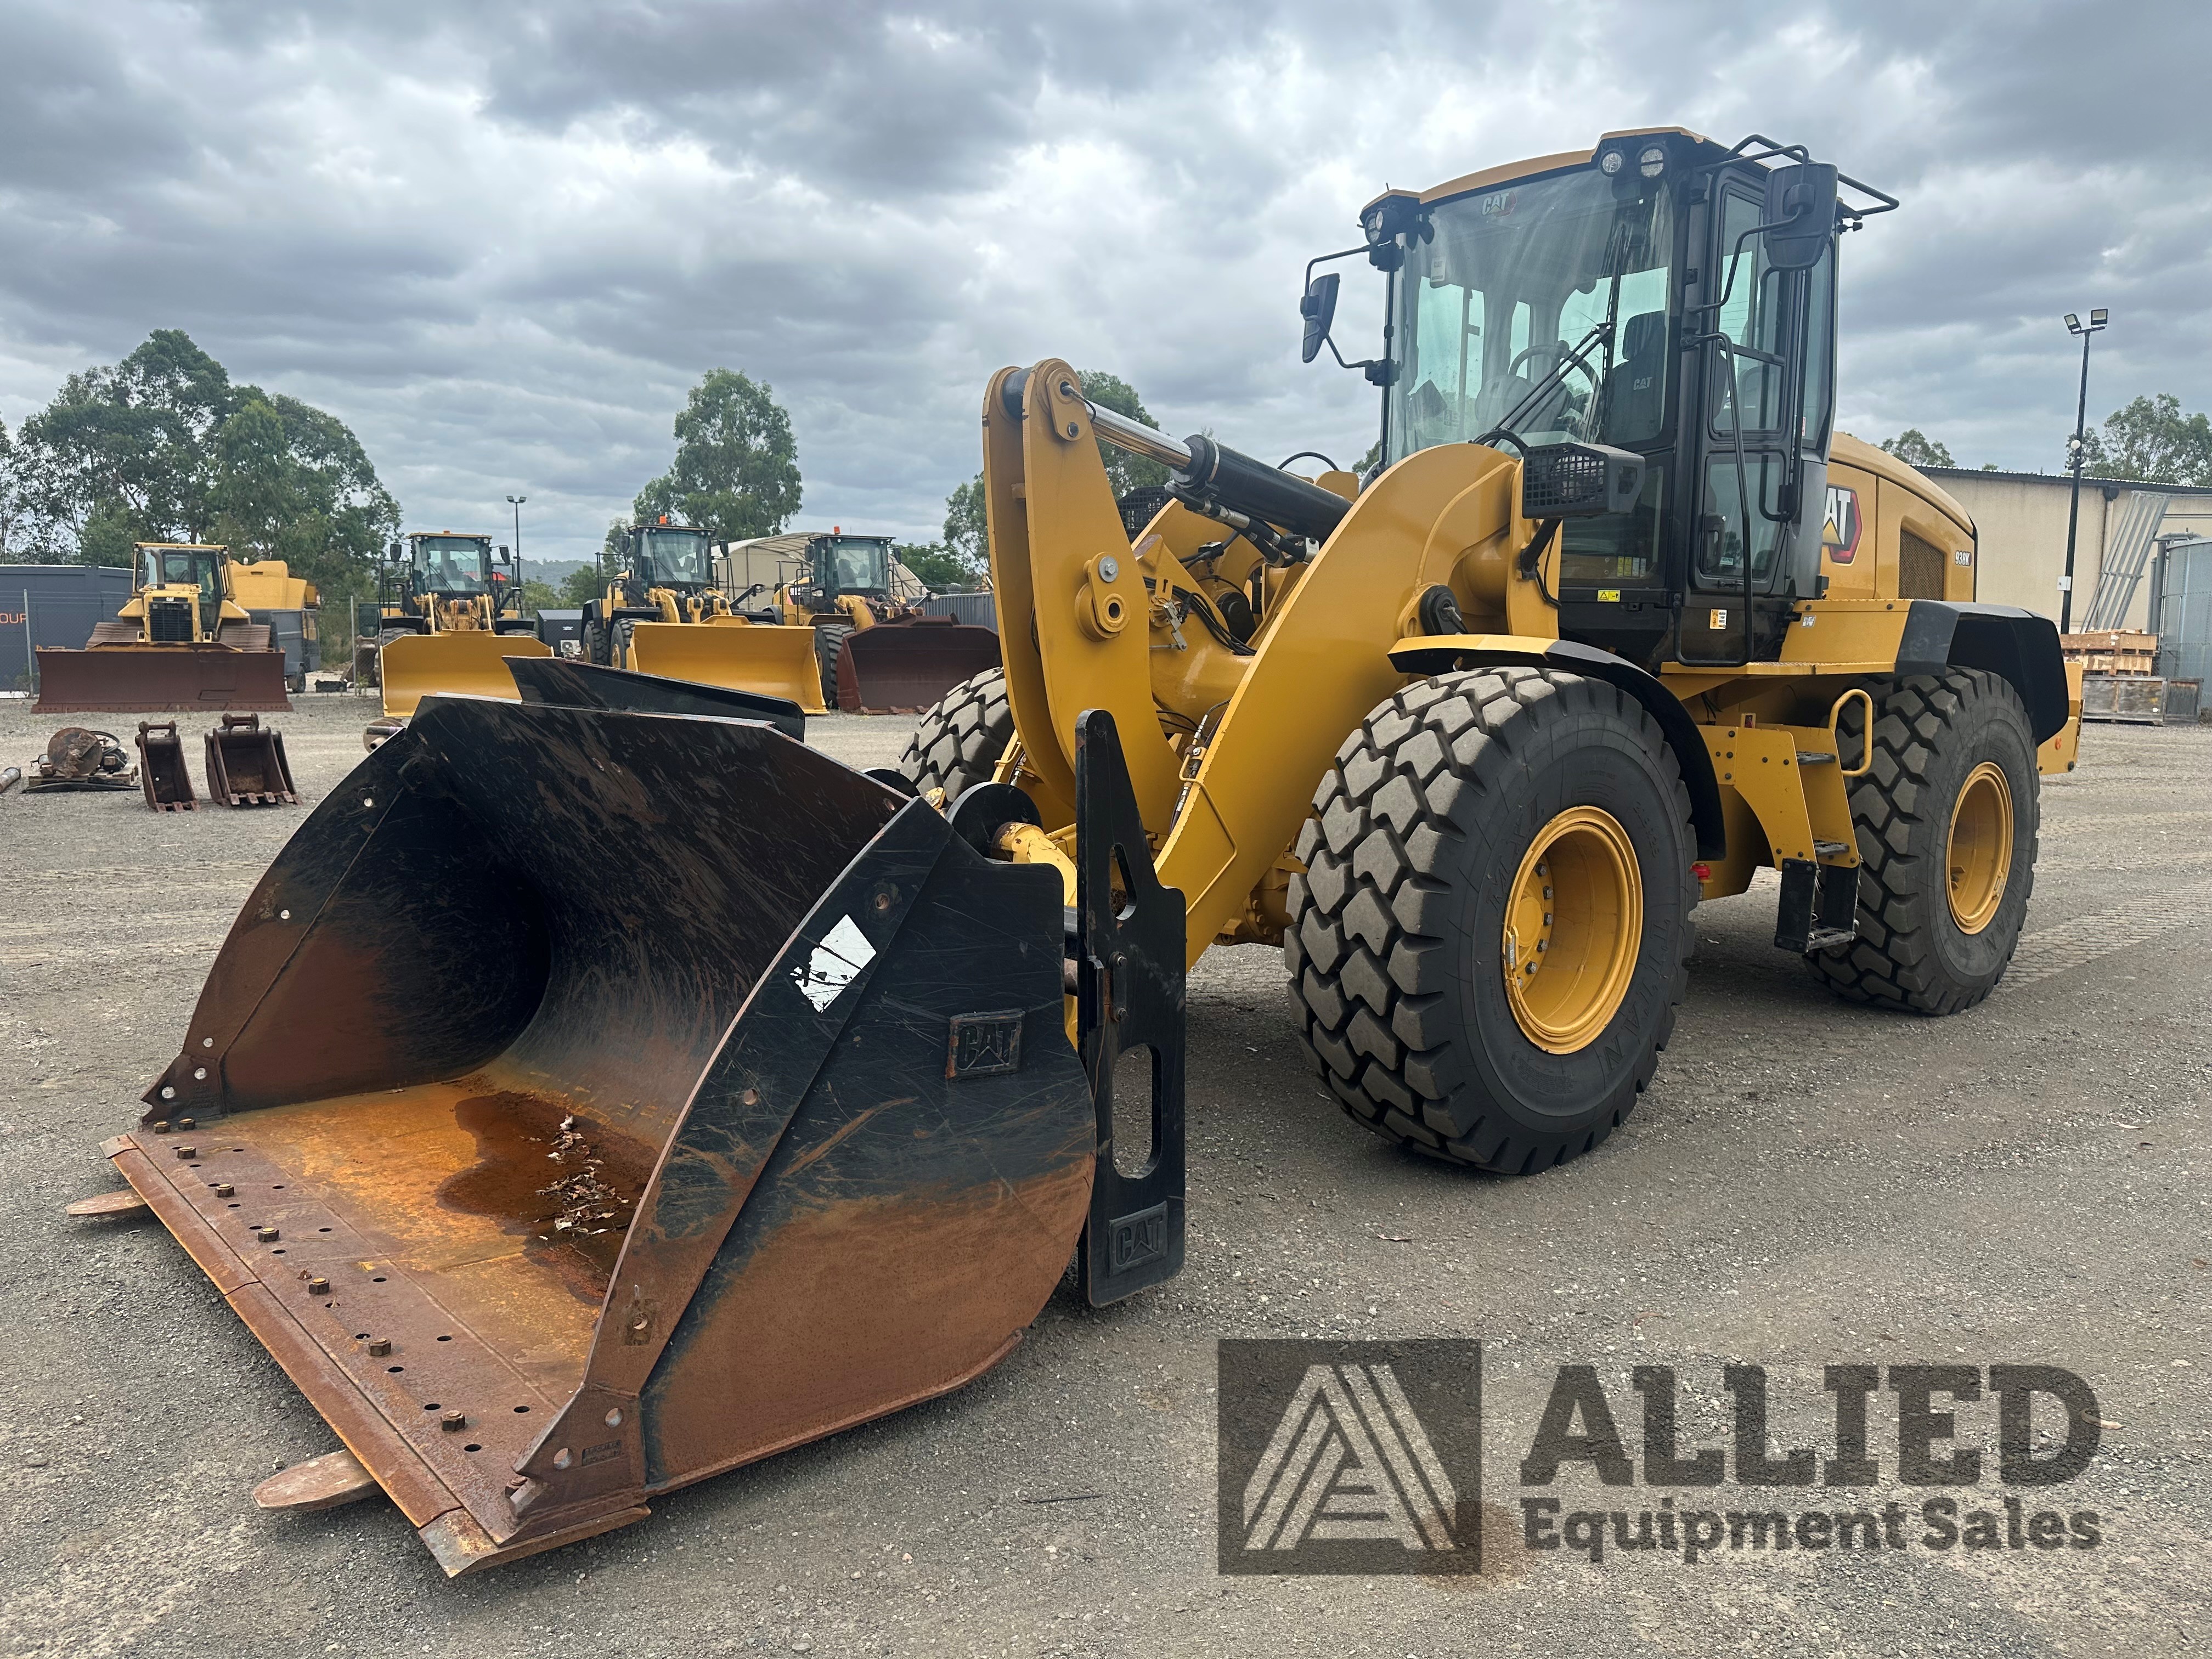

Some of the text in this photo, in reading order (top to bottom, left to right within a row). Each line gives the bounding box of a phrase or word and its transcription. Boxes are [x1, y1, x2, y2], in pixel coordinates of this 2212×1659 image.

[1482, 193, 1509, 215] CAT
[1633, 376, 1652, 390] CAT
[1823, 487, 1851, 545] AT
[1955, 551, 1971, 566] 938K
[1604, 916, 1671, 1076] TITAN
[957, 1022, 1018, 1070] CAT
[1116, 1214, 1163, 1266] CAT
